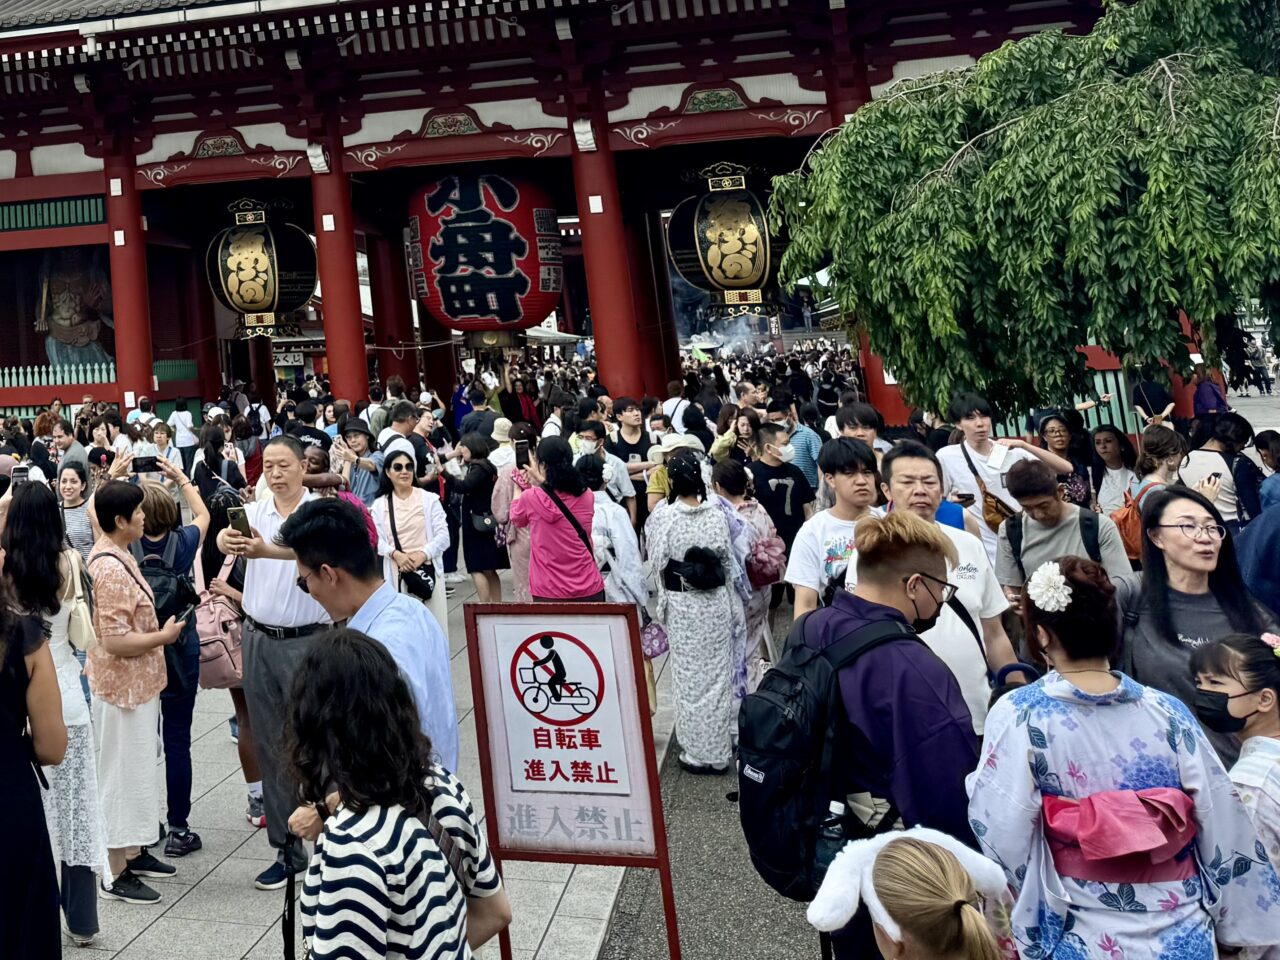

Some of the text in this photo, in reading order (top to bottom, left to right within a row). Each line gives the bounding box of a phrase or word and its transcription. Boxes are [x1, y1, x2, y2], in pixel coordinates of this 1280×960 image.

[424, 174, 531, 324] 小舟町
[768, 477, 795, 515] 7
[533, 727, 602, 750] 自転車
[523, 759, 618, 784] 進入禁止
[506, 804, 646, 842] 進入禁止
